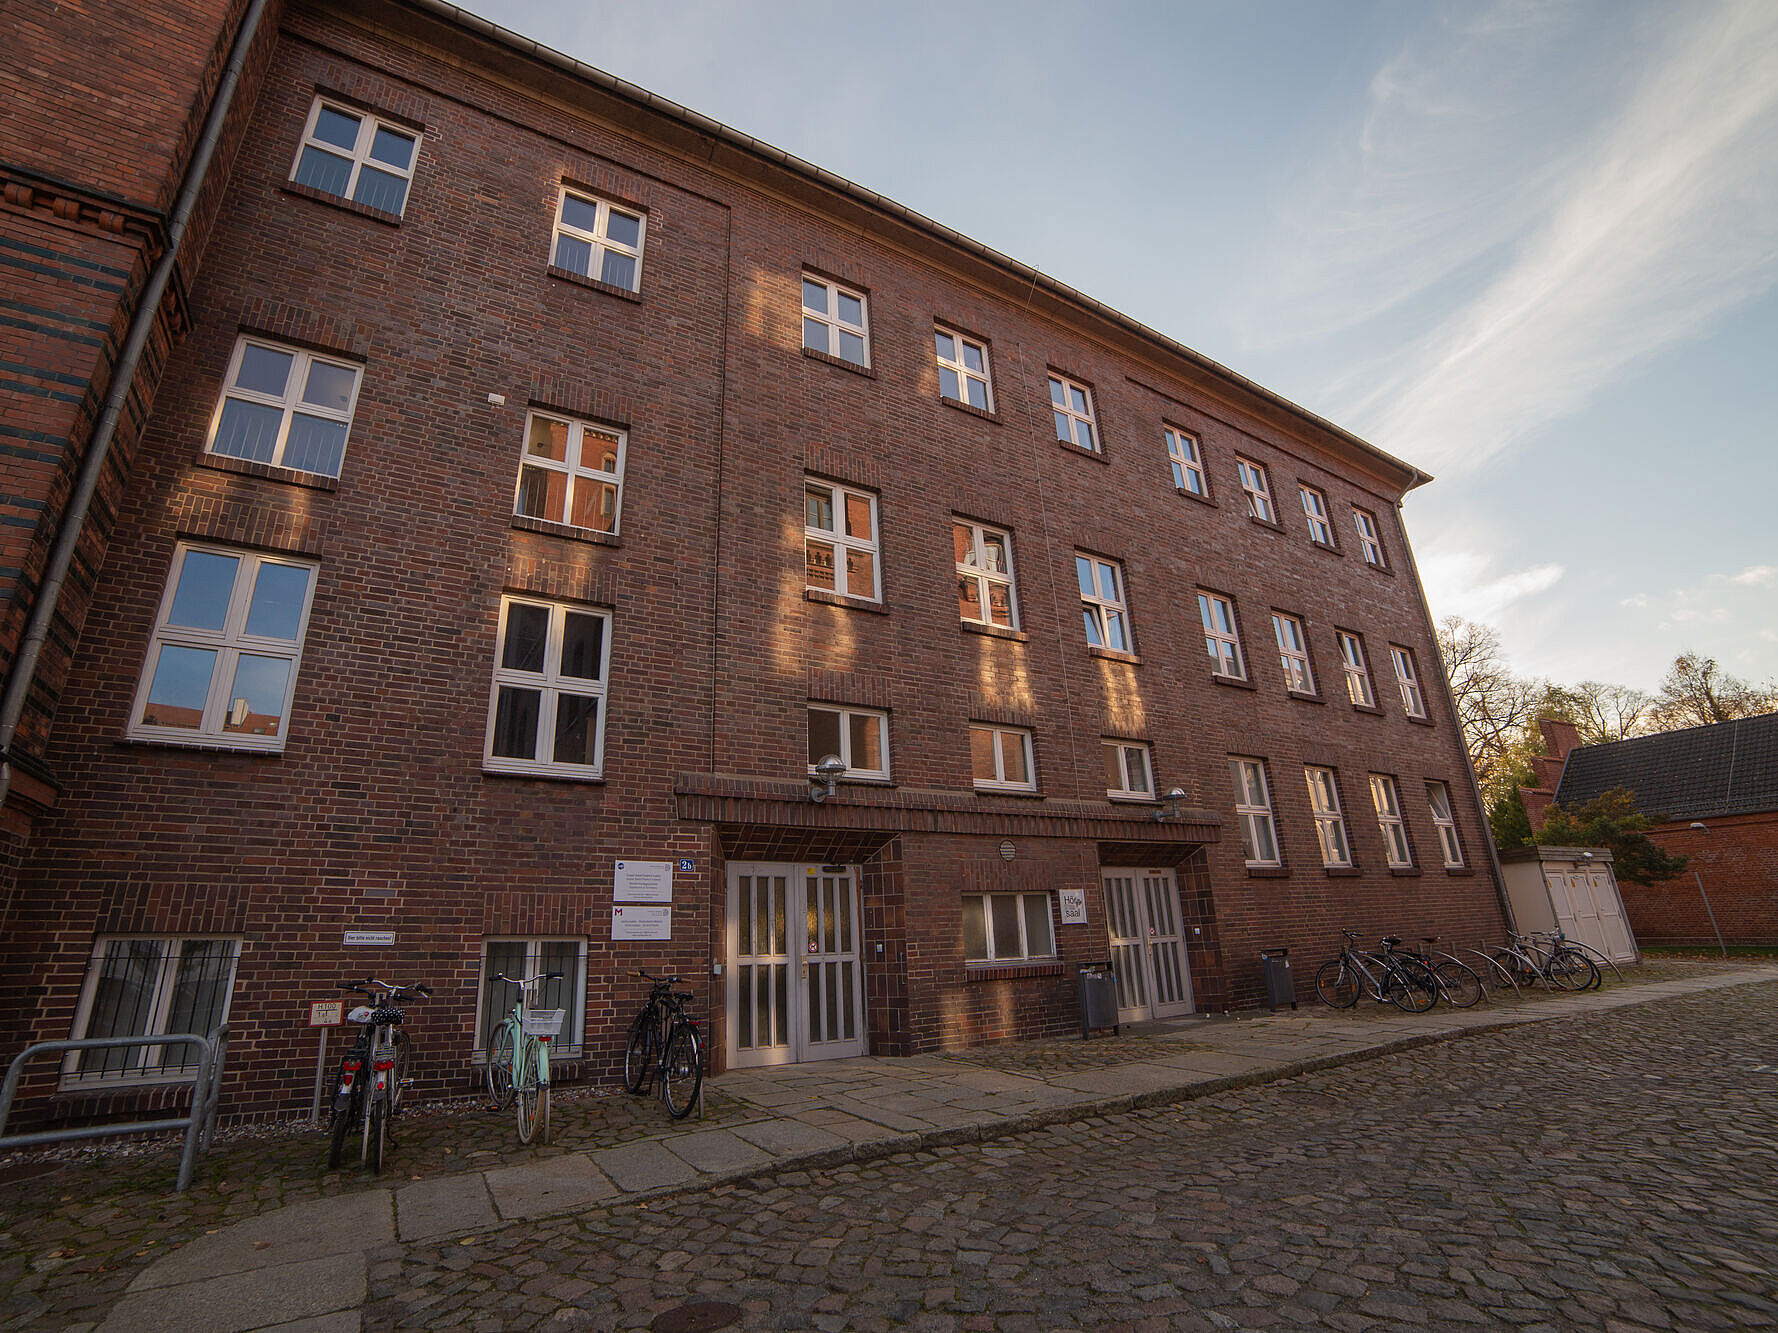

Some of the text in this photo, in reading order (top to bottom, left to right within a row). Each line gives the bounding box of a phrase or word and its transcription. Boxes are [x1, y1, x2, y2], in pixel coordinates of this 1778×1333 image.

[682, 860, 692, 870] 2b
[614, 908, 623, 916] M
[1066, 908, 1080, 918] saal
